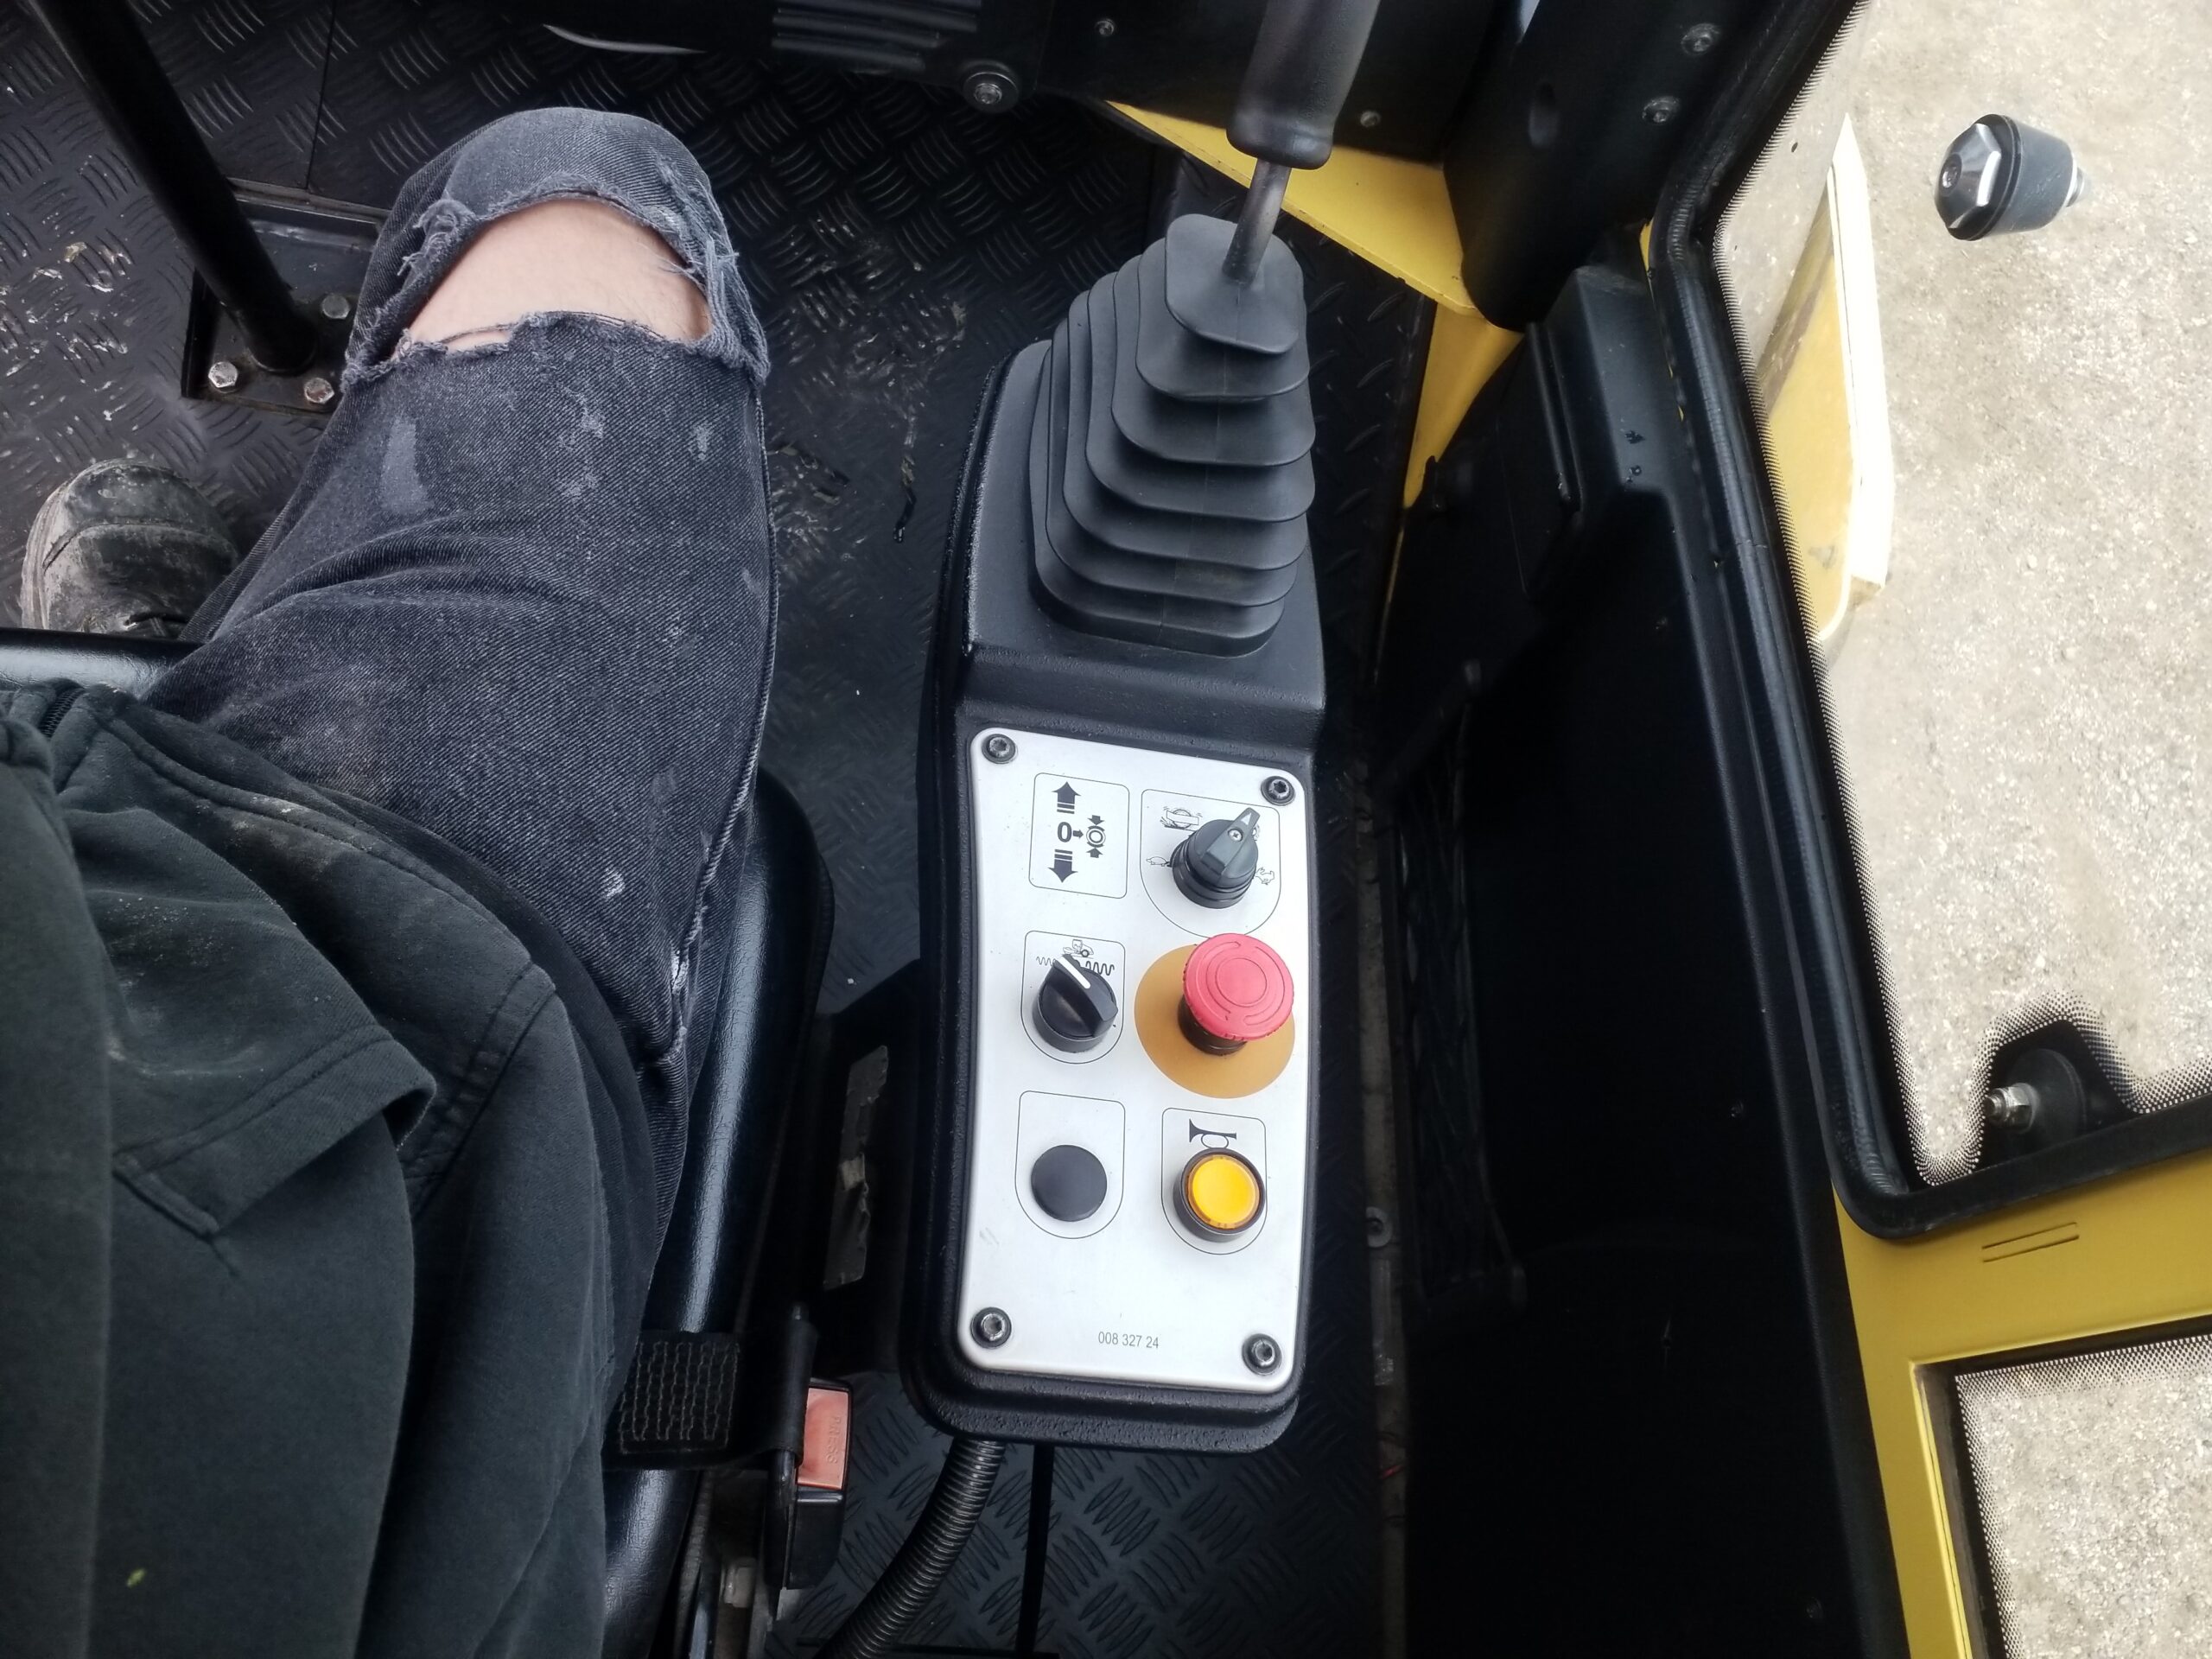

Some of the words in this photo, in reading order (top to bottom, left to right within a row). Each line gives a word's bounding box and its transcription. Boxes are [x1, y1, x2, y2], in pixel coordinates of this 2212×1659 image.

[1058, 822, 1072, 842] 0
[1098, 1331, 1119, 1345] 008
[1122, 1333, 1142, 1347] 327
[1146, 1336, 1159, 1349] 24
[826, 1416, 842, 1465] PRESS
